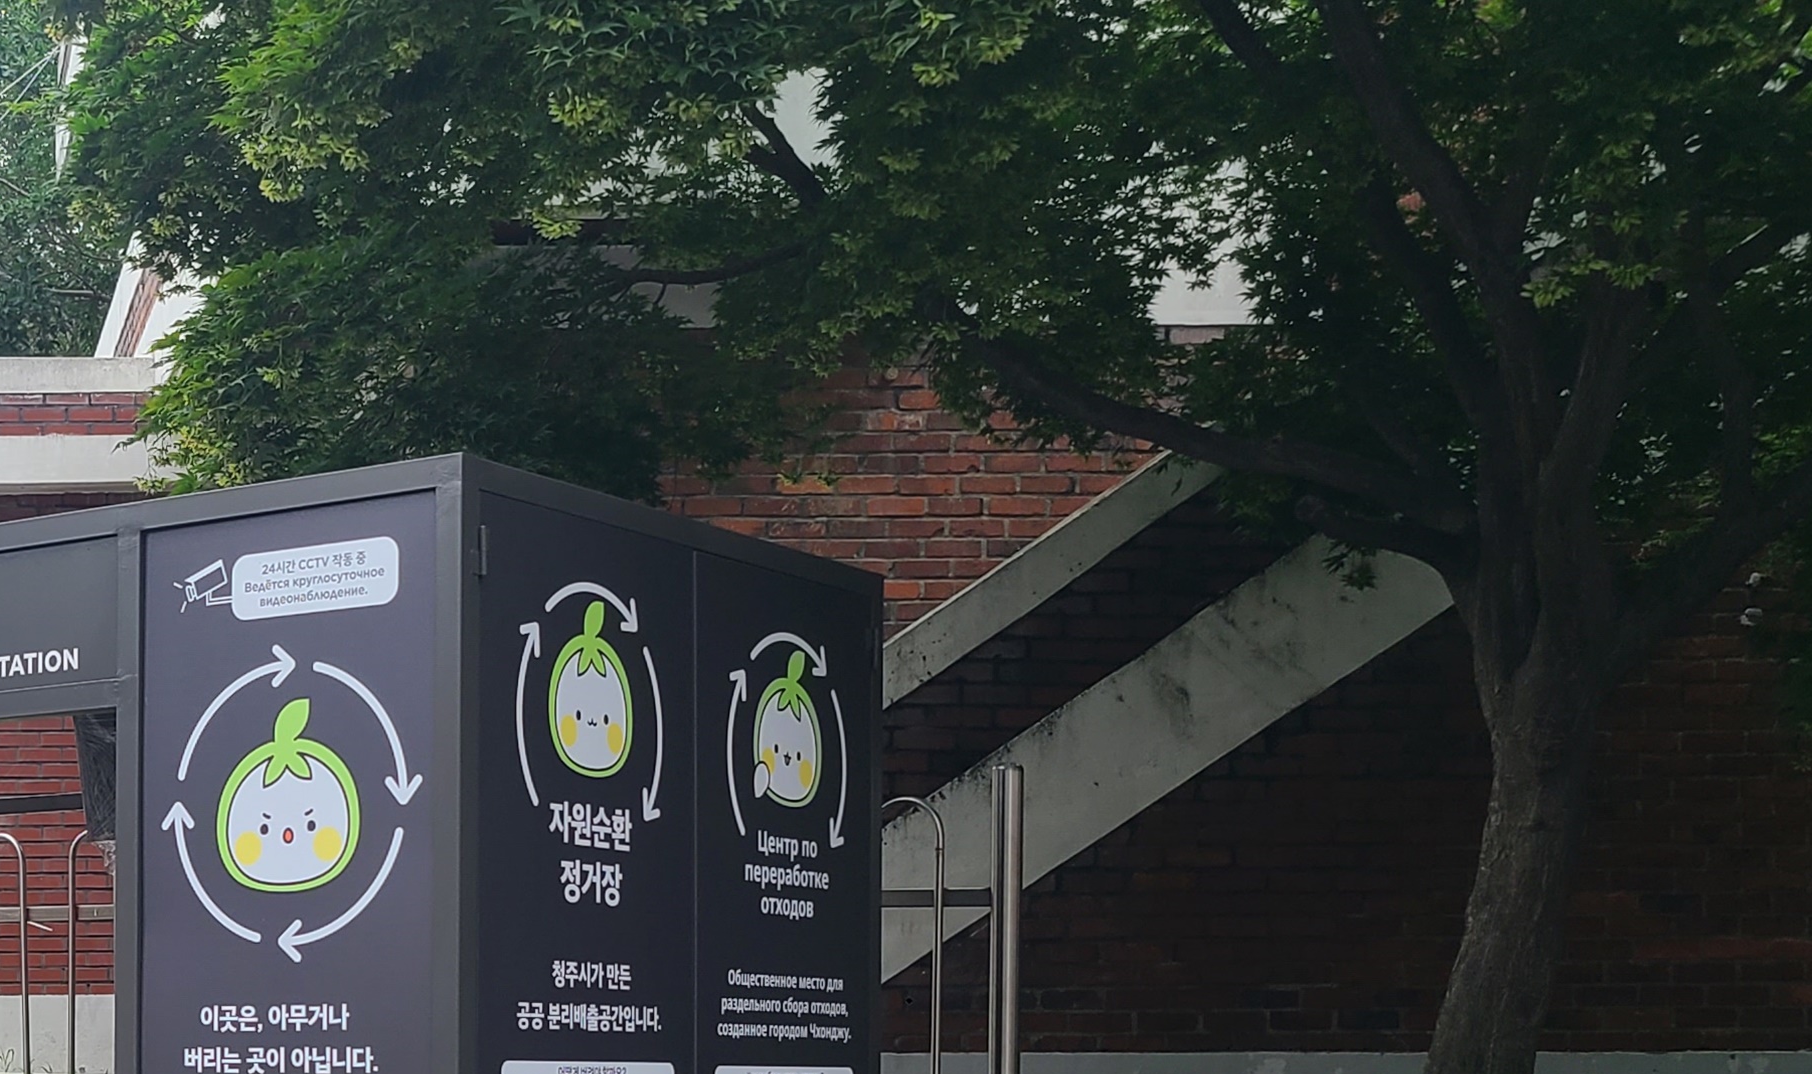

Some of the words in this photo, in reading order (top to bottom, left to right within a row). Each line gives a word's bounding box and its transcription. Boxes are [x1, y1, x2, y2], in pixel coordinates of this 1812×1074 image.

[261, 559, 296, 575] 24시간
[298, 556, 329, 570] CCTV
[332, 552, 353, 567] 작동
[355, 550, 366, 565] 중
[244, 579, 289, 593] Ведётся
[292, 567, 384, 588] круглосуточное
[259, 586, 368, 606] видеонаблюдение.
[549, 801, 632, 852] 자원순환
[758, 830, 798, 861] Центр
[801, 840, 817, 858] по
[560, 859, 623, 907] 정거장
[744, 864, 829, 889] переработке
[760, 897, 814, 919] отходов
[552, 960, 604, 988] 청주시가
[606, 963, 631, 990] 만든
[727, 969, 797, 988] Общественное
[798, 977, 825, 990] место
[826, 978, 843, 992] для
[200, 1005, 262, 1032] 이곳은,
[268, 1003, 350, 1031] 아무거나
[516, 1001, 544, 1030] 공공
[546, 1003, 661, 1032] 분리배출공간입니다.
[720, 997, 781, 1014] раздельного
[782, 997, 809, 1017] сбора
[810, 1002, 848, 1017] отходов,
[717, 1023, 767, 1038] созданное
[768, 1024, 808, 1041] городом
[809, 1023, 851, 1043] Чхонджу.
[184, 1046, 241, 1073] 버리는
[245, 1046, 285, 1074] 곳이
[290, 1046, 378, 1074] 아닙니다.
